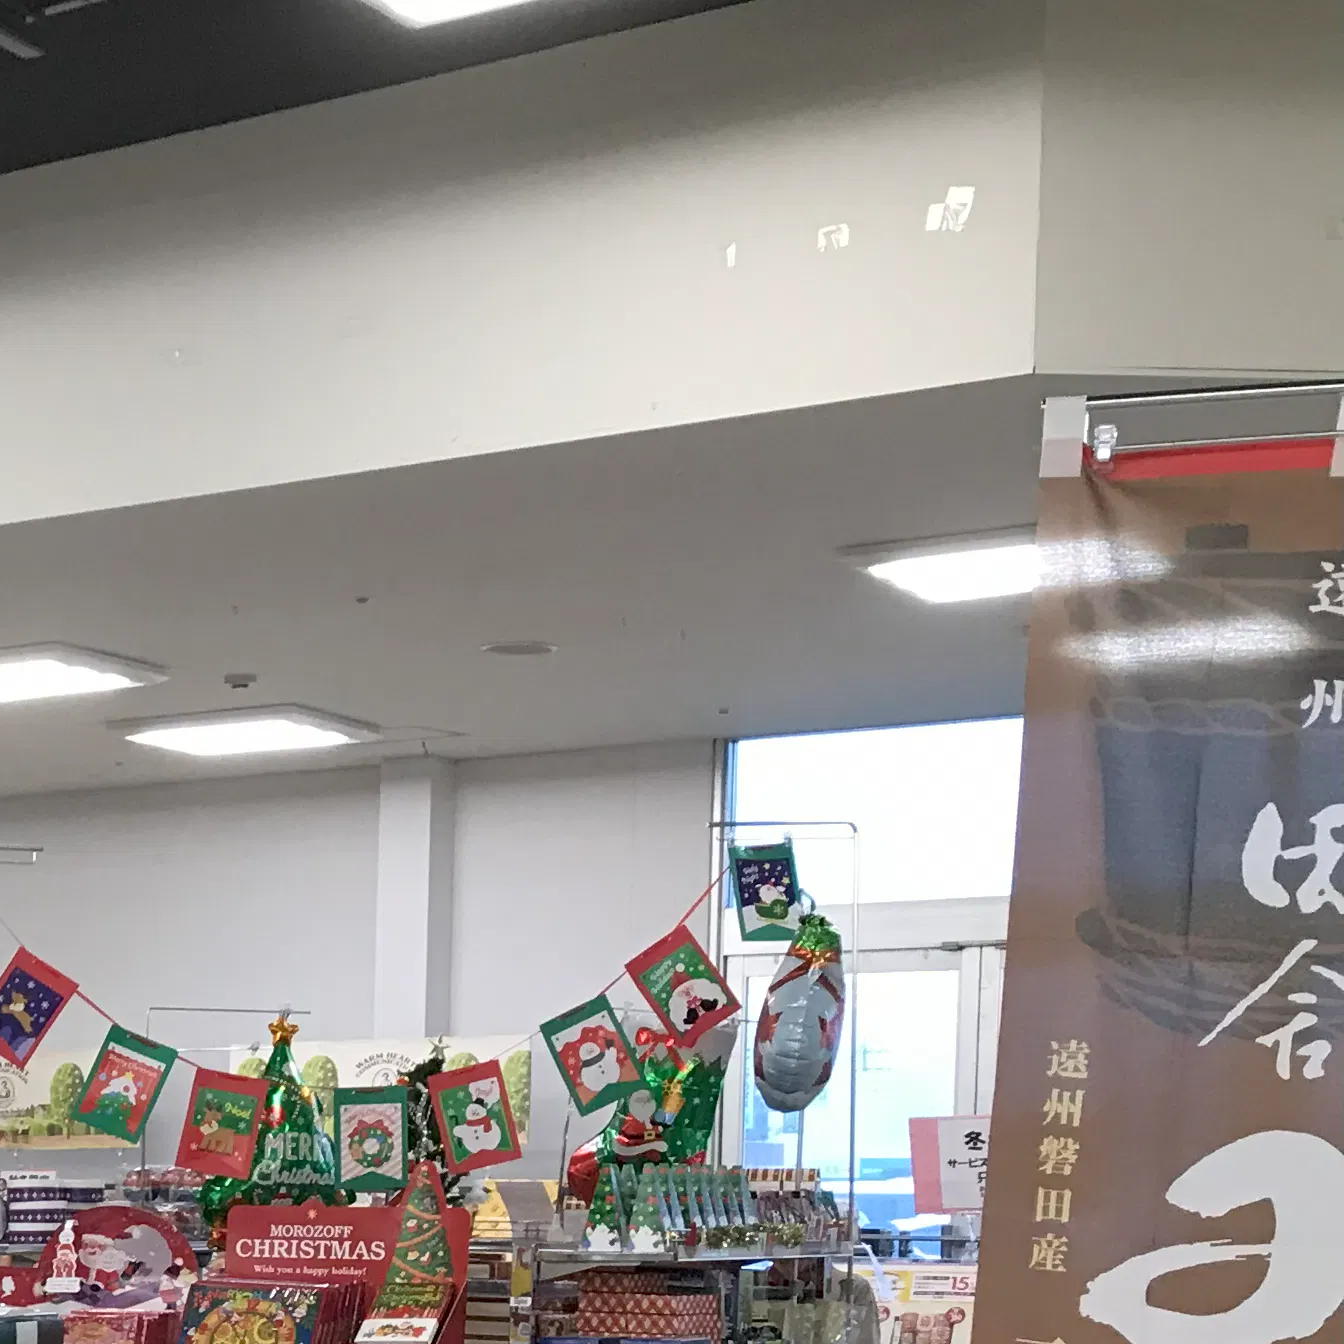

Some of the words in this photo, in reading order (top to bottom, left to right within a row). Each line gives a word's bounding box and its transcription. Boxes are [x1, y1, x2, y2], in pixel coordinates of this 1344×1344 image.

[1028, 1040, 1091, 1275] 遠州磐田産
[269, 1224, 353, 1239] MOROZOFF
[235, 1238, 386, 1260] CHRISTMAS
[254, 1264, 274, 1274] Wish
[277, 1267, 293, 1276] you
[303, 1266, 329, 1277] happy
[331, 1265, 367, 1277] holiday!
